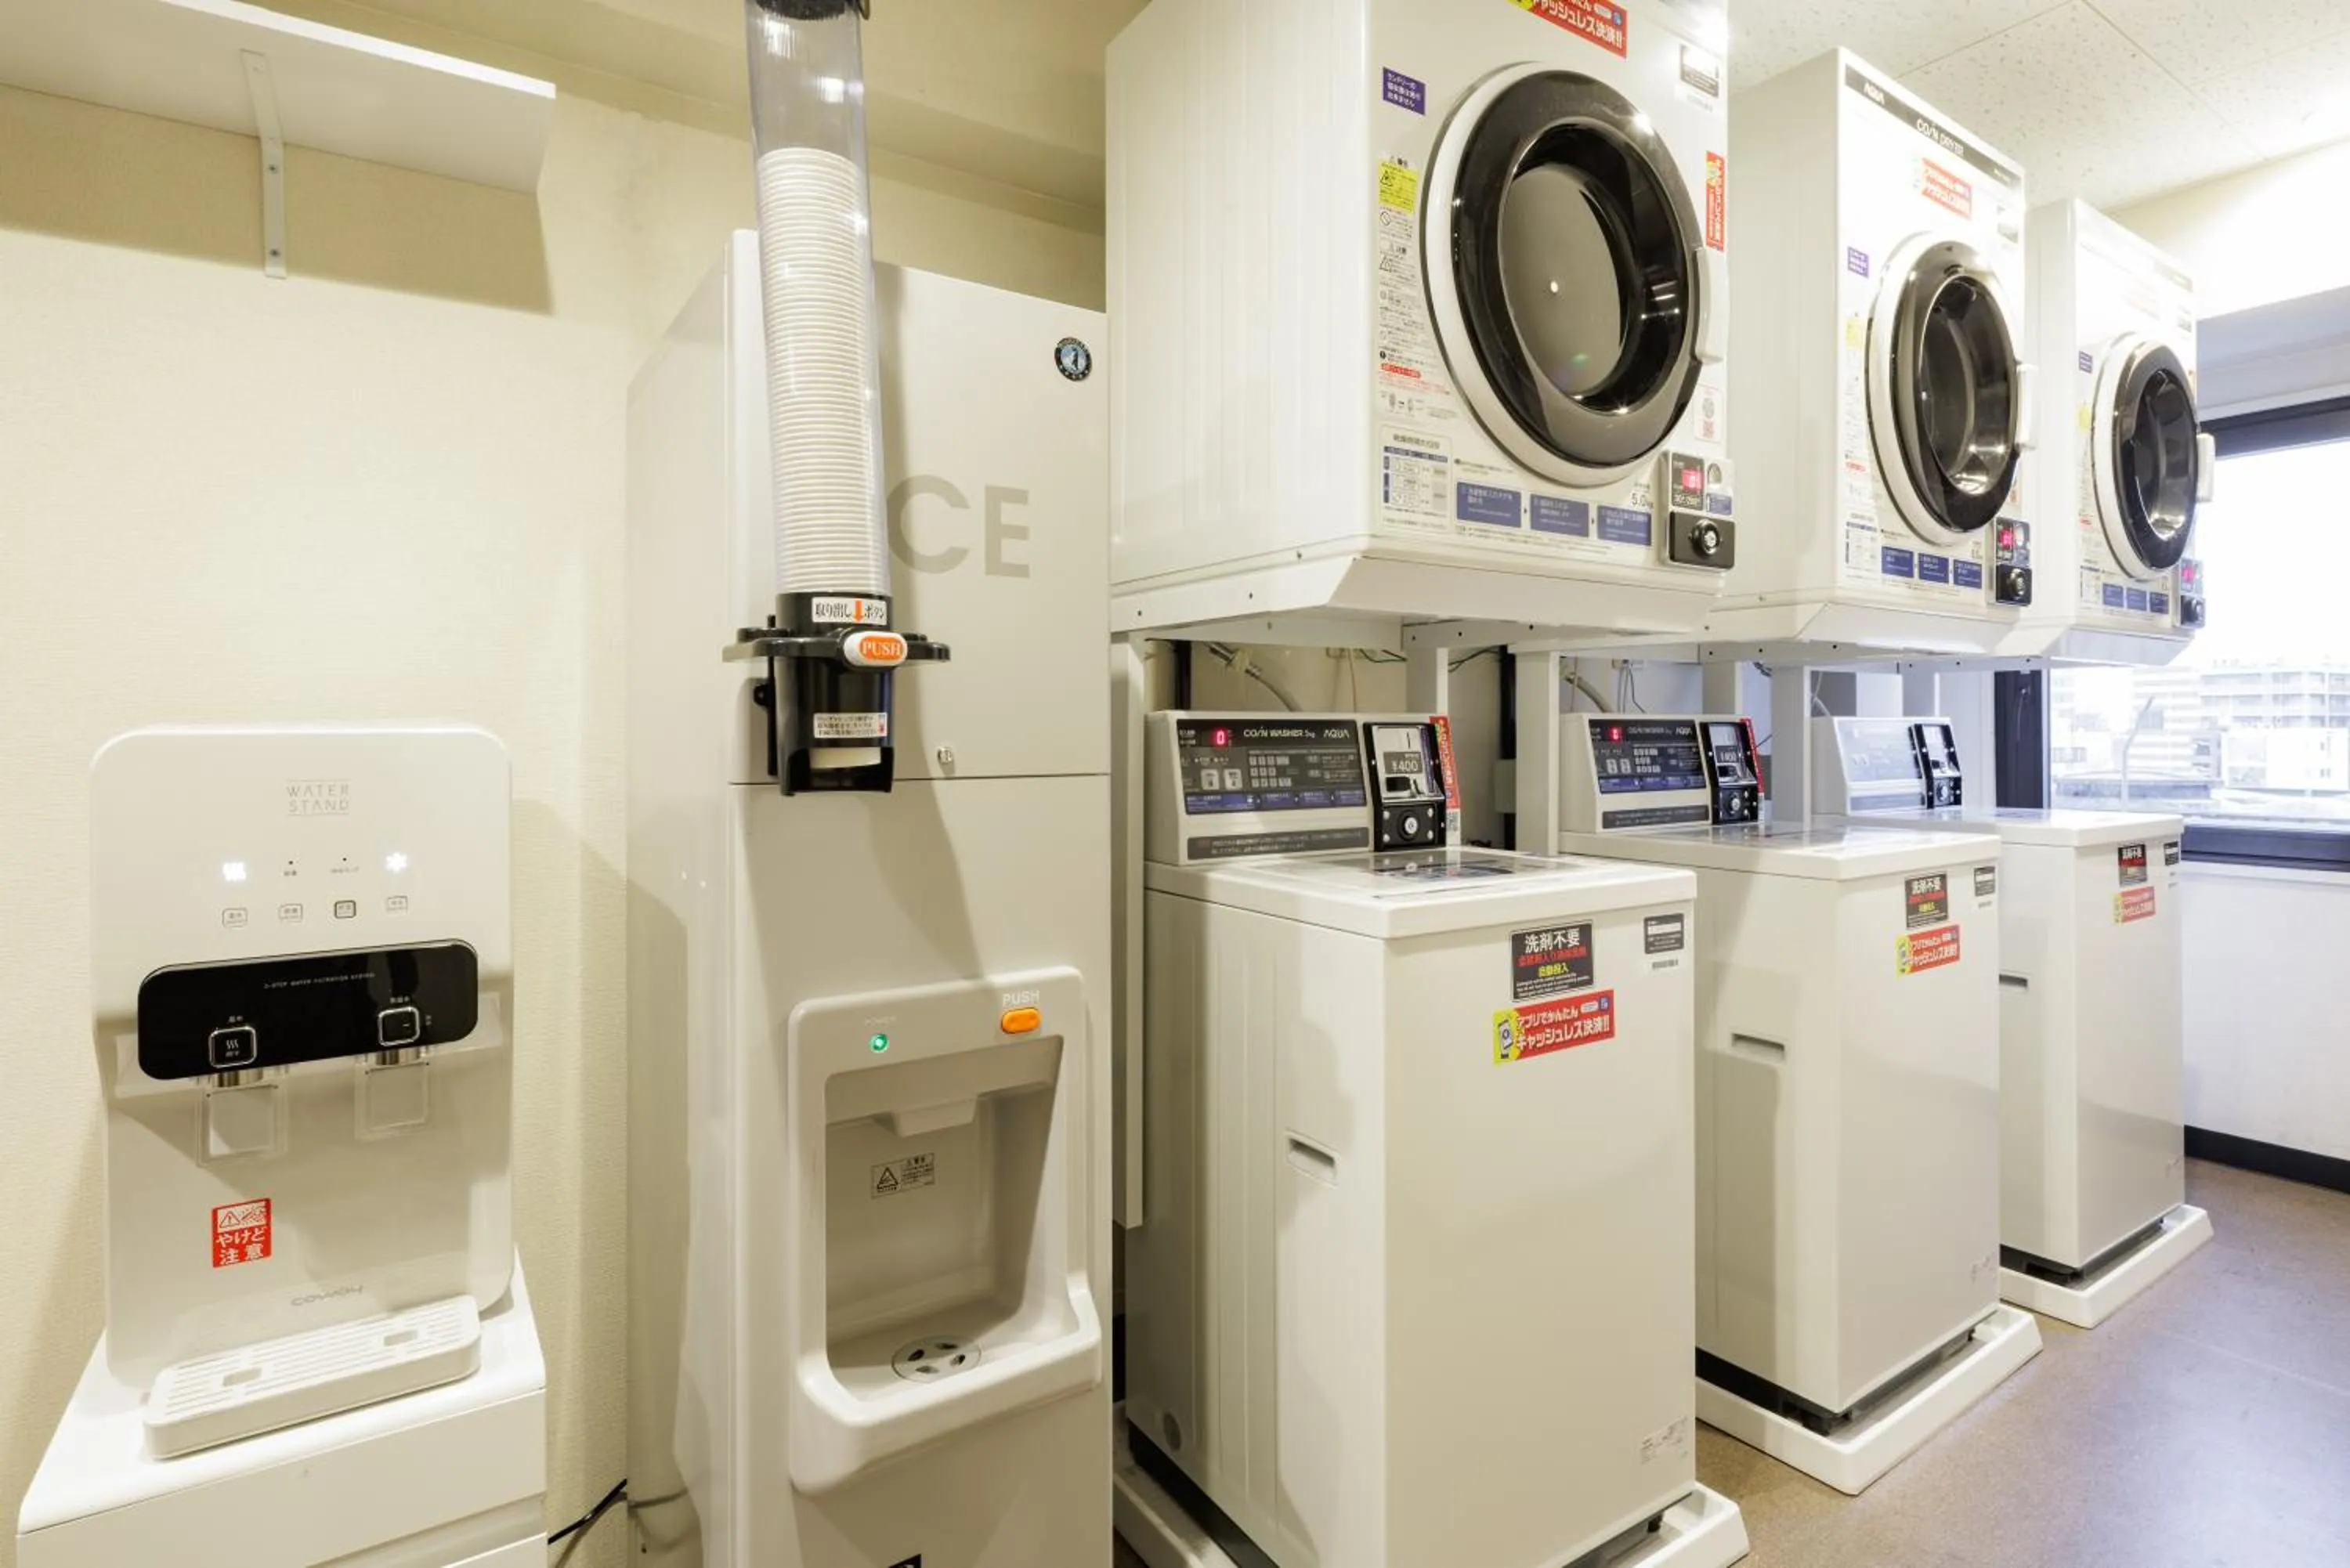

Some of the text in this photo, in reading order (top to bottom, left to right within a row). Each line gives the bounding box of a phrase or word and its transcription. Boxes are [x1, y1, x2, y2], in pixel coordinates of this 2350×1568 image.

[887, 474, 1030, 578] CE
[862, 641, 901, 656] PUSH
[1323, 728, 1350, 739] AQUA
[286, 783, 349, 797] WATER
[288, 798, 349, 814] STAND
[1525, 927, 1580, 953] 洗剤不要
[1002, 990, 1040, 1006] PUSH
[215, 1227, 266, 1248] やけど
[219, 1243, 264, 1266] 注意
